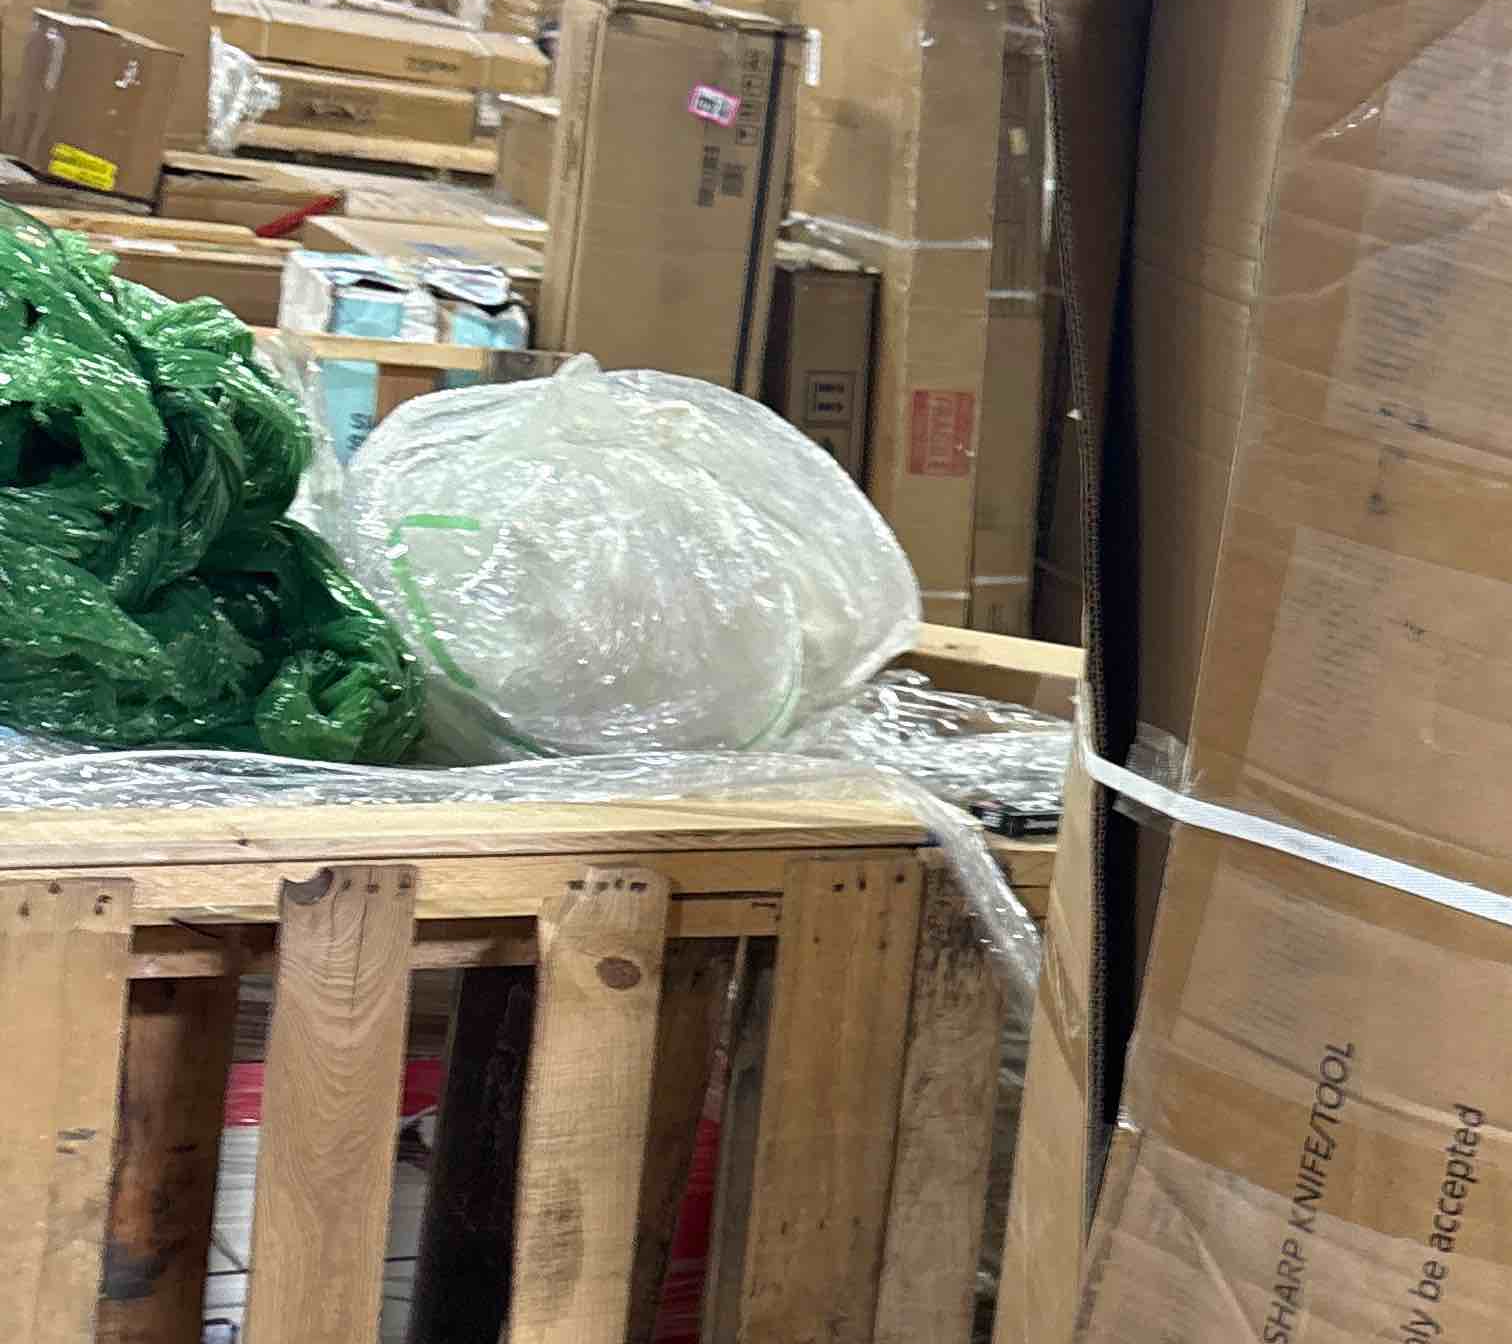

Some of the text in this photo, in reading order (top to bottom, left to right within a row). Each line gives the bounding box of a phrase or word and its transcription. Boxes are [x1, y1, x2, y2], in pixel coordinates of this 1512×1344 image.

[1288, 1040, 1356, 1236] KNIFE/TOOL
[1428, 1105, 1486, 1254] accepted
[1410, 1256, 1447, 1305] be
